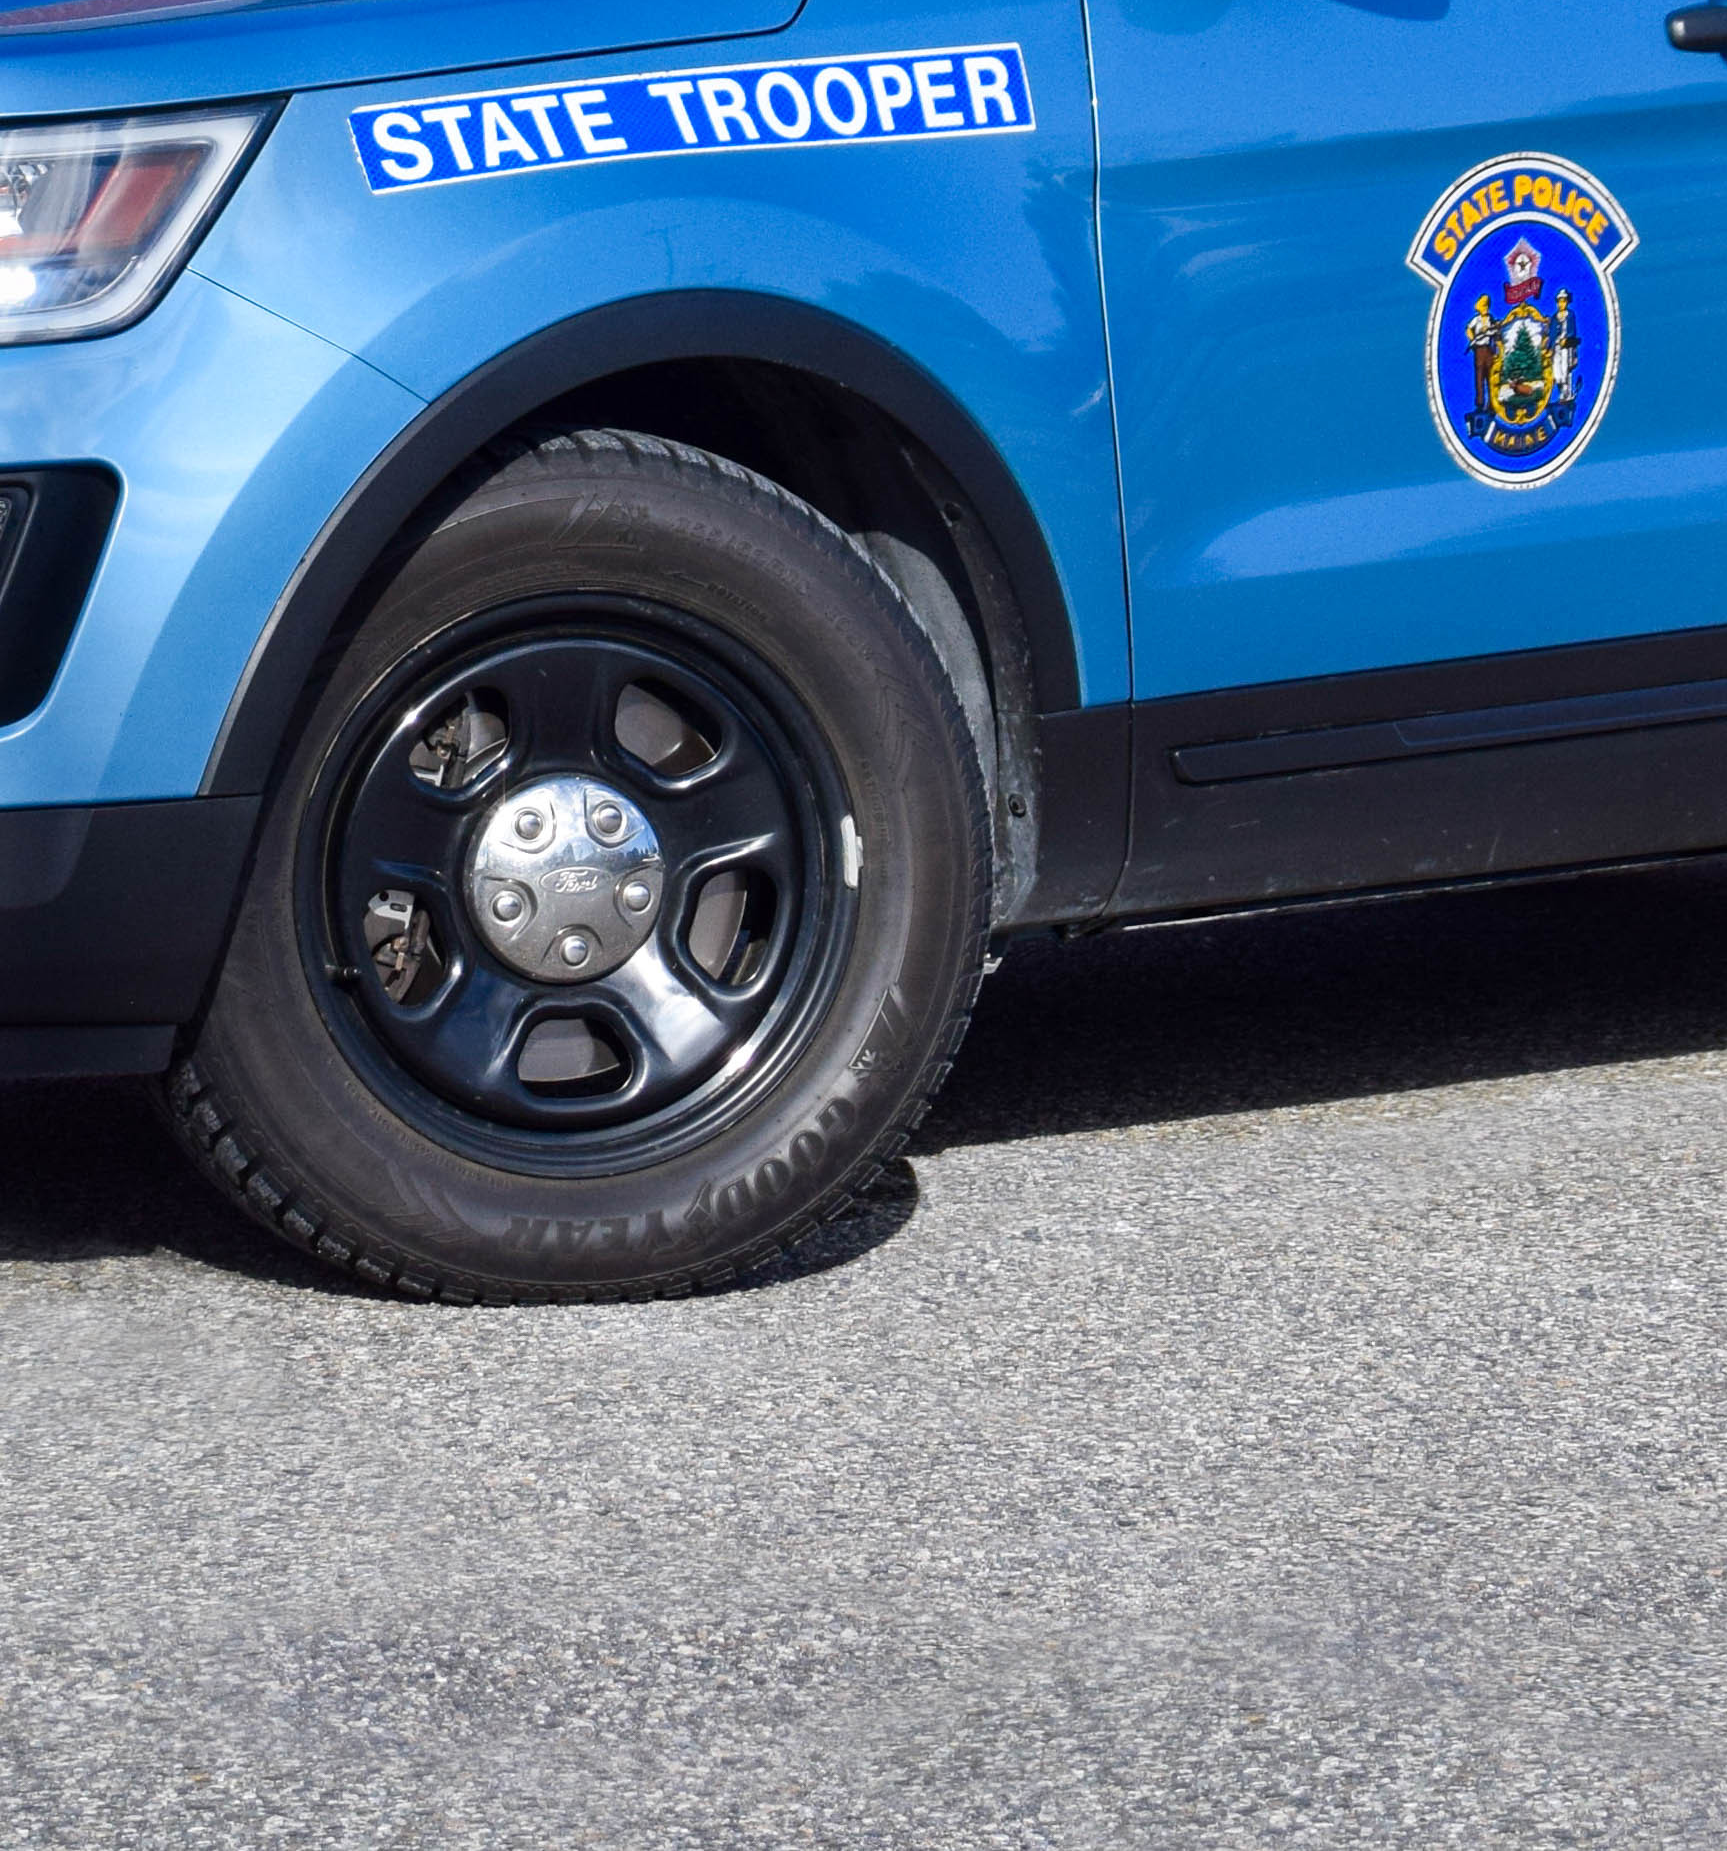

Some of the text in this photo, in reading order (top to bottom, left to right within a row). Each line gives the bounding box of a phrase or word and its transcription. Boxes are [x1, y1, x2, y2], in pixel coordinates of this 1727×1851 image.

[373, 56, 1017, 181] STATE TROOPER
[1434, 175, 1609, 260] STATE POLICE
[555, 870, 598, 893] Ford
